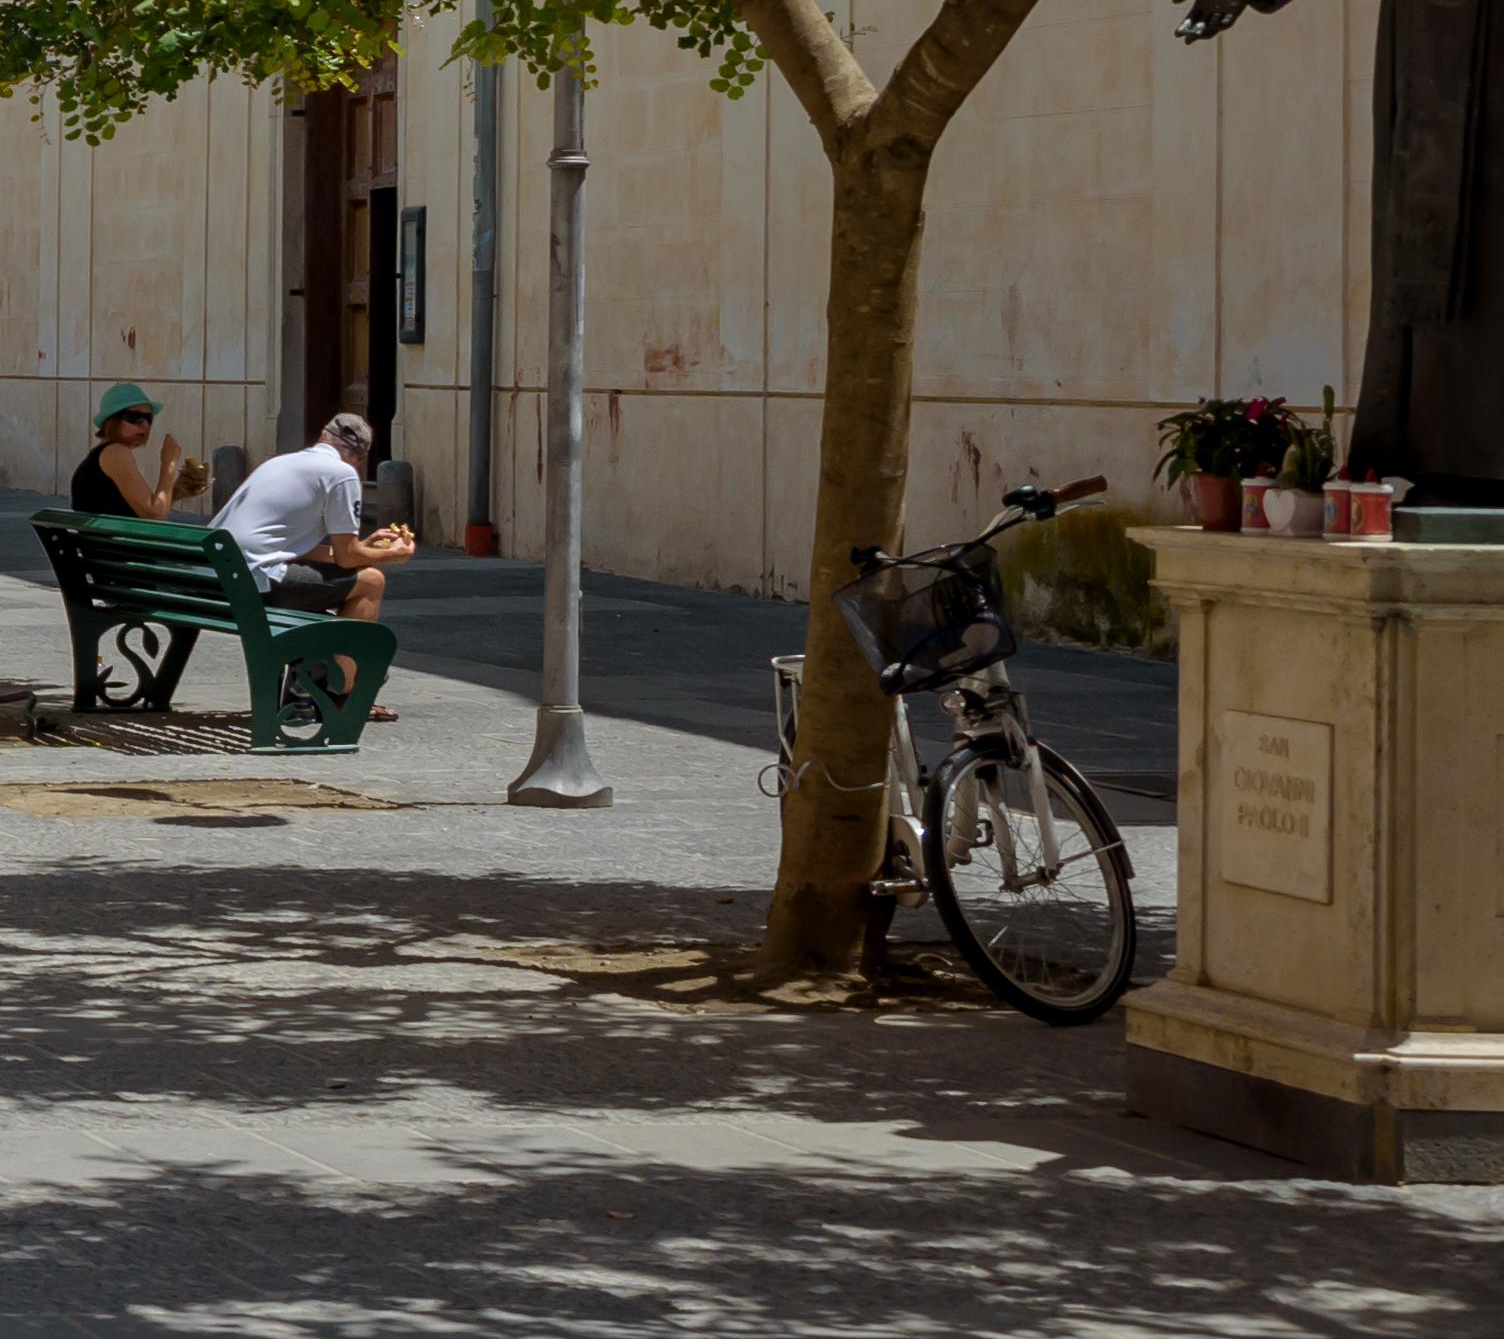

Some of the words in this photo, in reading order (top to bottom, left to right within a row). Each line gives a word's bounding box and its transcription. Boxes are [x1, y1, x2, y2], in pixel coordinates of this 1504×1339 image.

[1258, 733, 1291, 758] SAN
[1233, 765, 1316, 804] GIOVANNI
[1237, 803, 1296, 835] PAOLO
